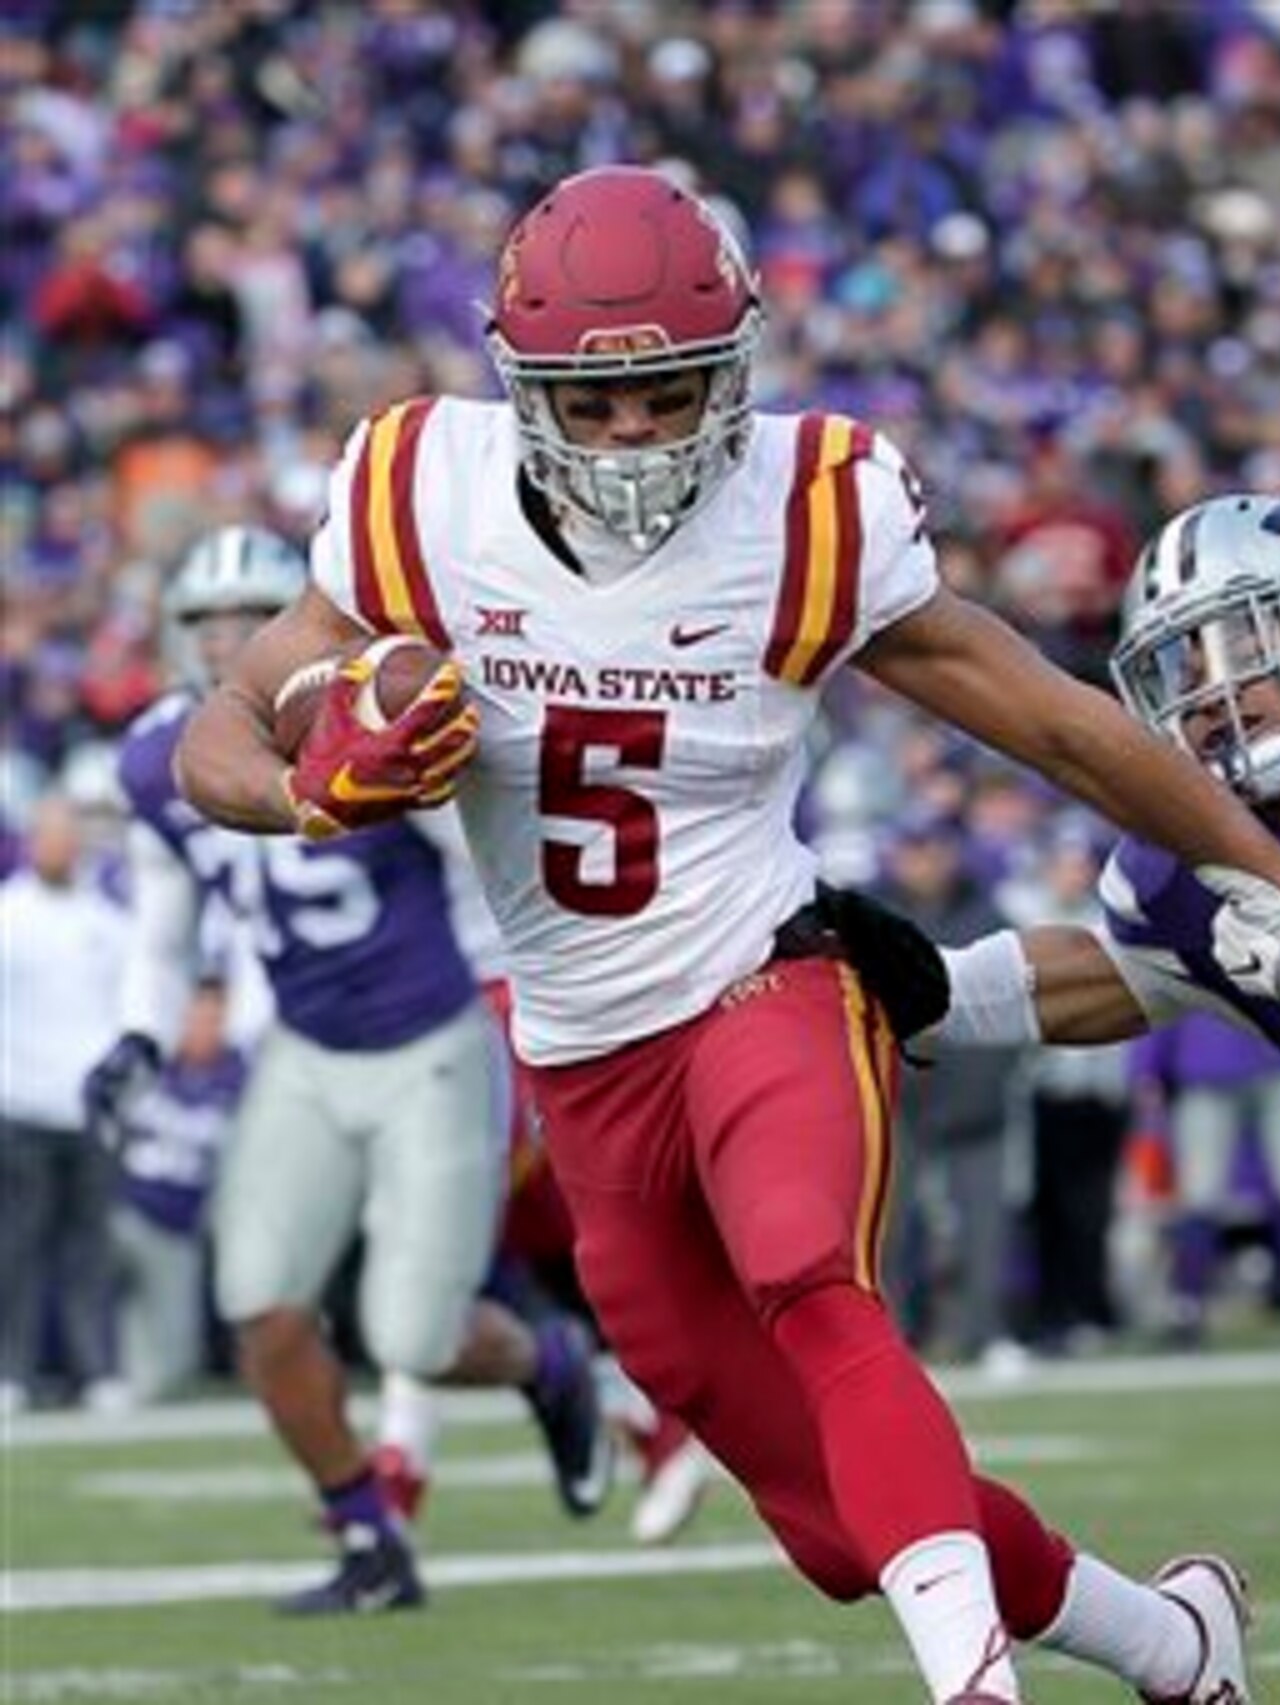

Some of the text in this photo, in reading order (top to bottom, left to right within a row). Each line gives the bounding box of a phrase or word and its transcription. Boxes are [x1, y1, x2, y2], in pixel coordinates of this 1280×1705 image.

[474, 605, 528, 640] XII
[482, 655, 736, 703] IOWA STATE
[538, 703, 667, 918] 5
